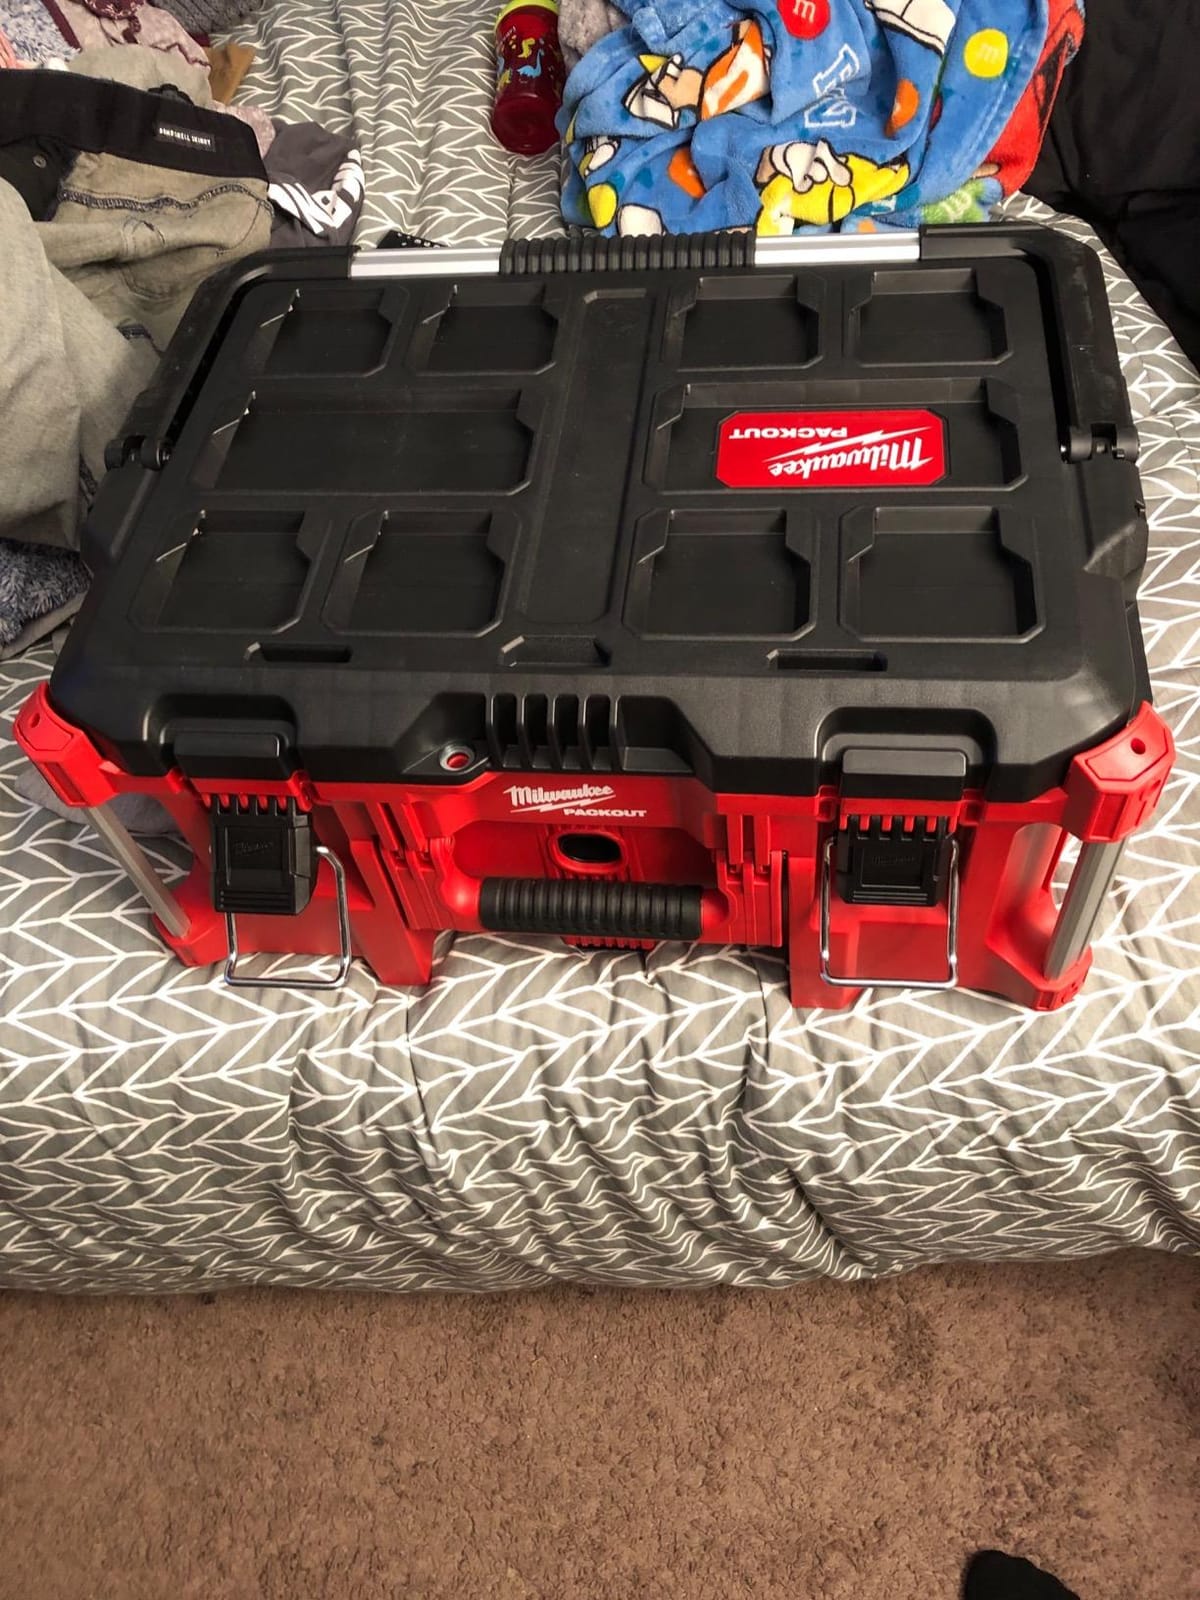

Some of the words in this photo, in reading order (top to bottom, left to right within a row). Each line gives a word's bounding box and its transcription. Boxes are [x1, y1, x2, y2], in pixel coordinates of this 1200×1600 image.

[728, 427, 848, 440] PACKOUT
[767, 437, 934, 479] Milwaukee
[502, 784, 615, 806] Milwaukee
[563, 808, 647, 817] PACKOUT
